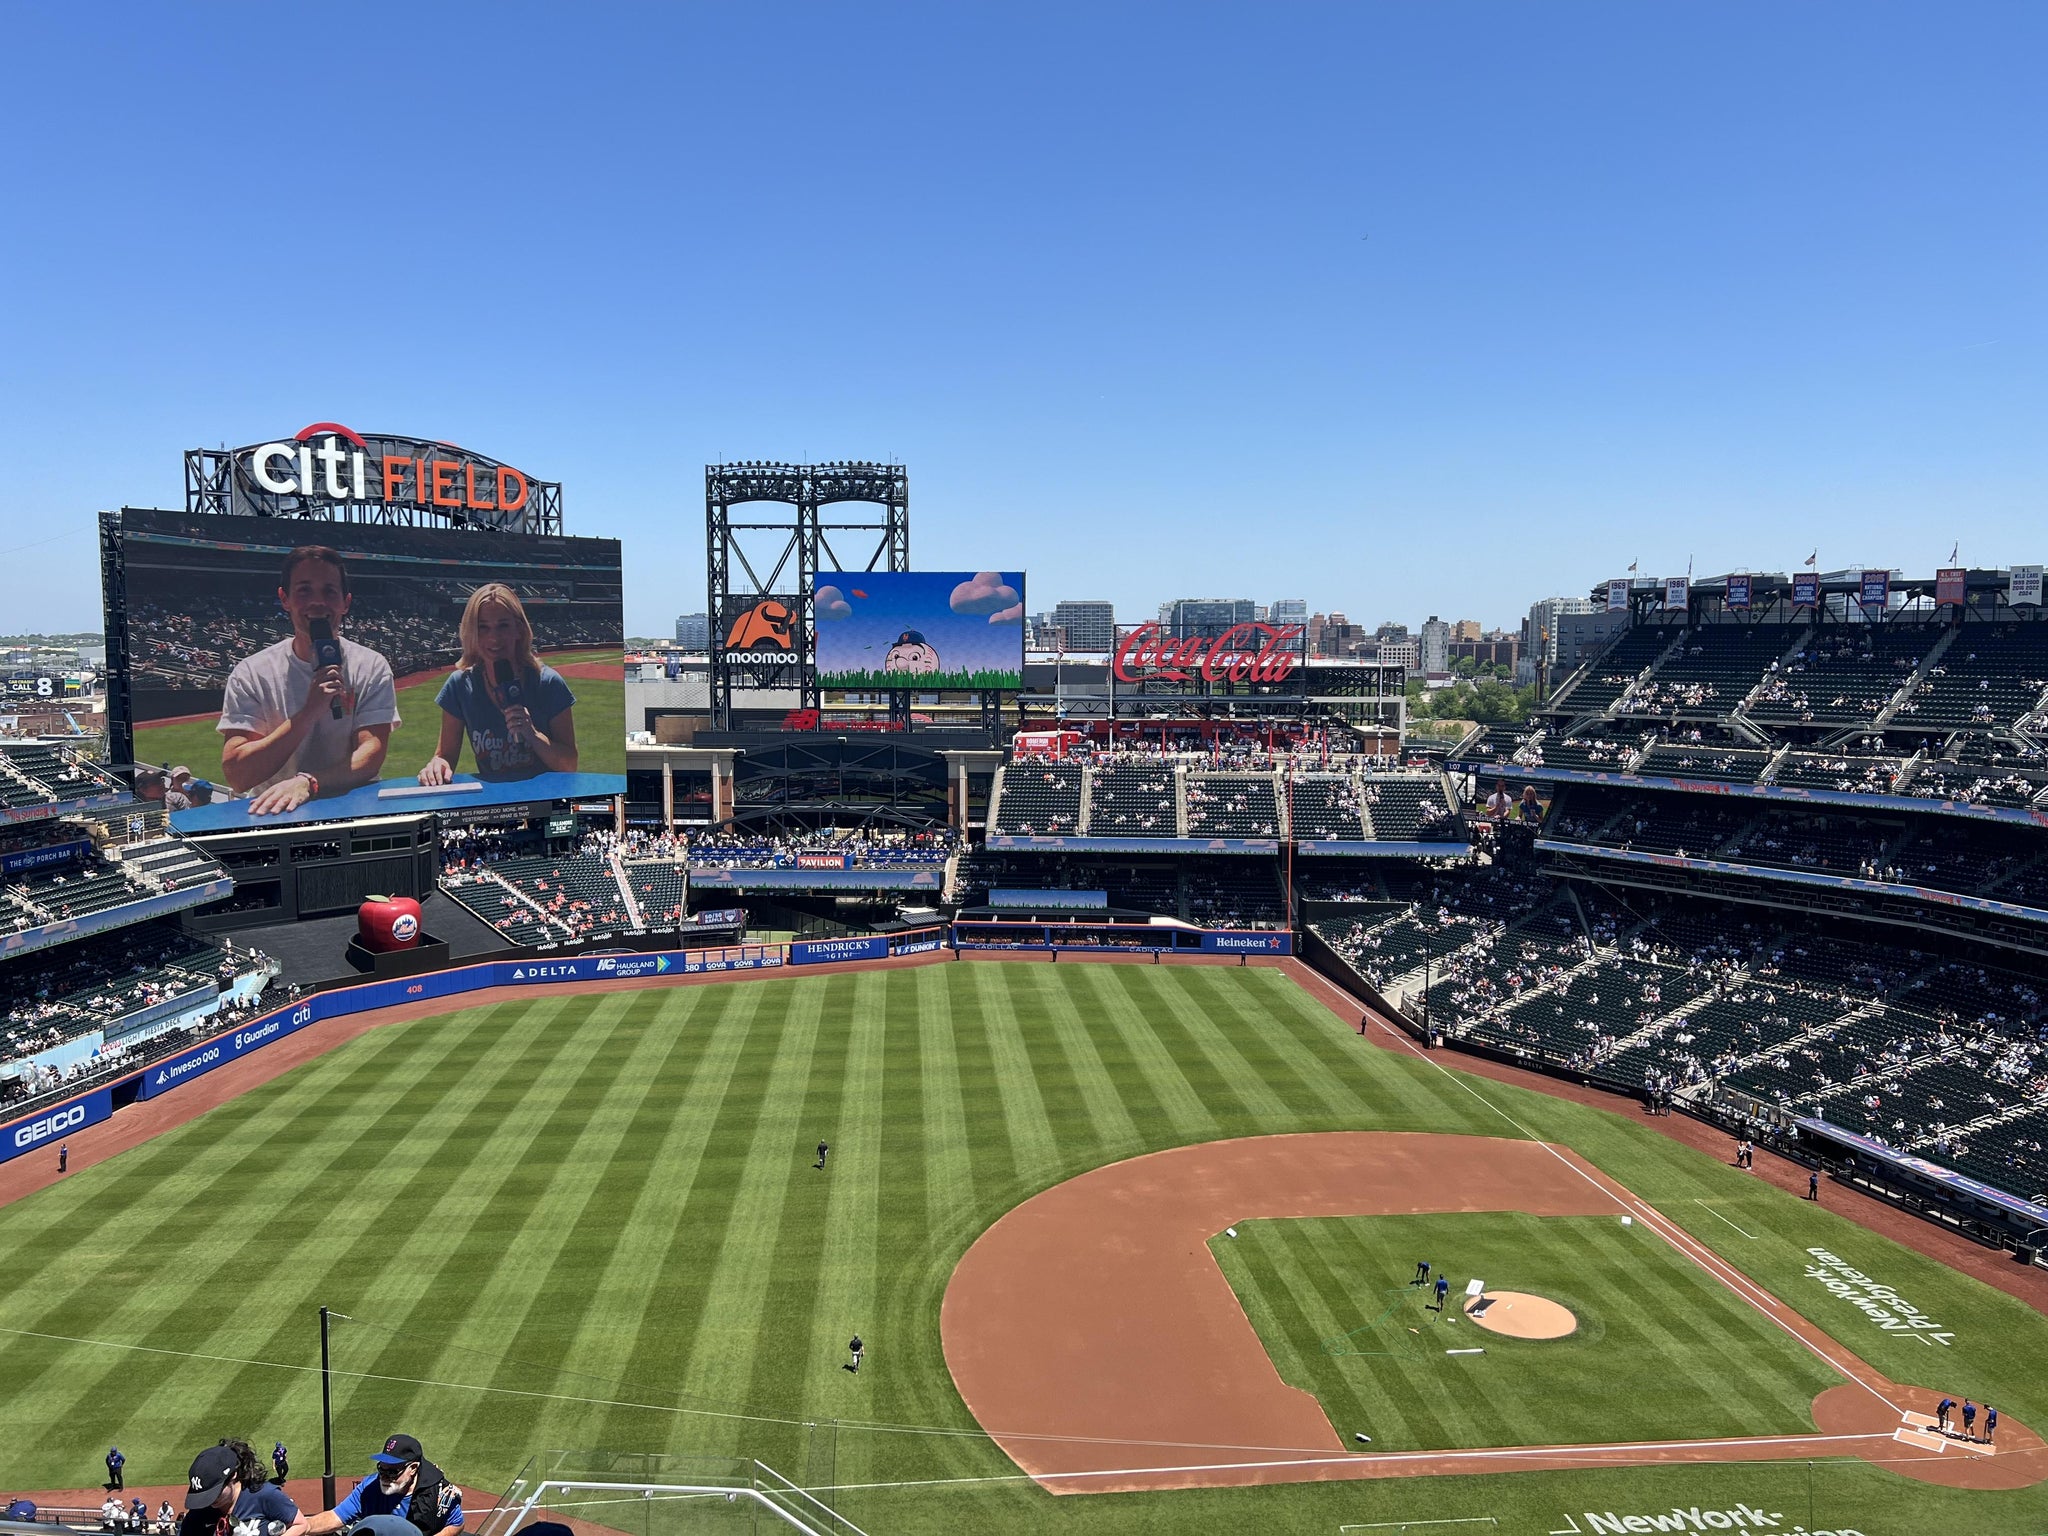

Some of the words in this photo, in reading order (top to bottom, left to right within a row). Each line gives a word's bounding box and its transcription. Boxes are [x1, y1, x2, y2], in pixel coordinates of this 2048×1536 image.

[253, 436, 366, 499] citi
[382, 455, 529, 511] FIELD
[1669, 580, 1685, 588] 1986
[726, 652, 798, 664] moomoo
[37, 677, 53, 696] 8
[9, 859, 22, 868] THE
[36, 851, 58, 863] PORCH
[58, 849, 71, 858] BAR
[807, 940, 870, 953] HENDRICK'S
[1216, 937, 1266, 948] Heineken
[761, 957, 781, 965] GOYA
[831, 952, 848, 960] GIN
[616, 961, 655, 969] HAUGLAND
[685, 964, 700, 972] 380
[706, 961, 727, 969] GOYA
[734, 959, 754, 967] GOYA
[528, 965, 577, 977] DELTA
[407, 984, 422, 993] 408
[293, 1006, 311, 1026] citi
[100, 1040, 122, 1054] Coors
[121, 1031, 141, 1046] LIGHT
[145, 1025, 164, 1037] FIESTA
[165, 1017, 181, 1028] DECK
[243, 1021, 279, 1045] Guardian
[170, 1056, 202, 1078] Invesco
[202, 1047, 220, 1063] QQQ
[1523, 1060, 1543, 1070] DELTA
[15, 1105, 85, 1148] GEICO
[1806, 1247, 1943, 1329] Presbyterian
